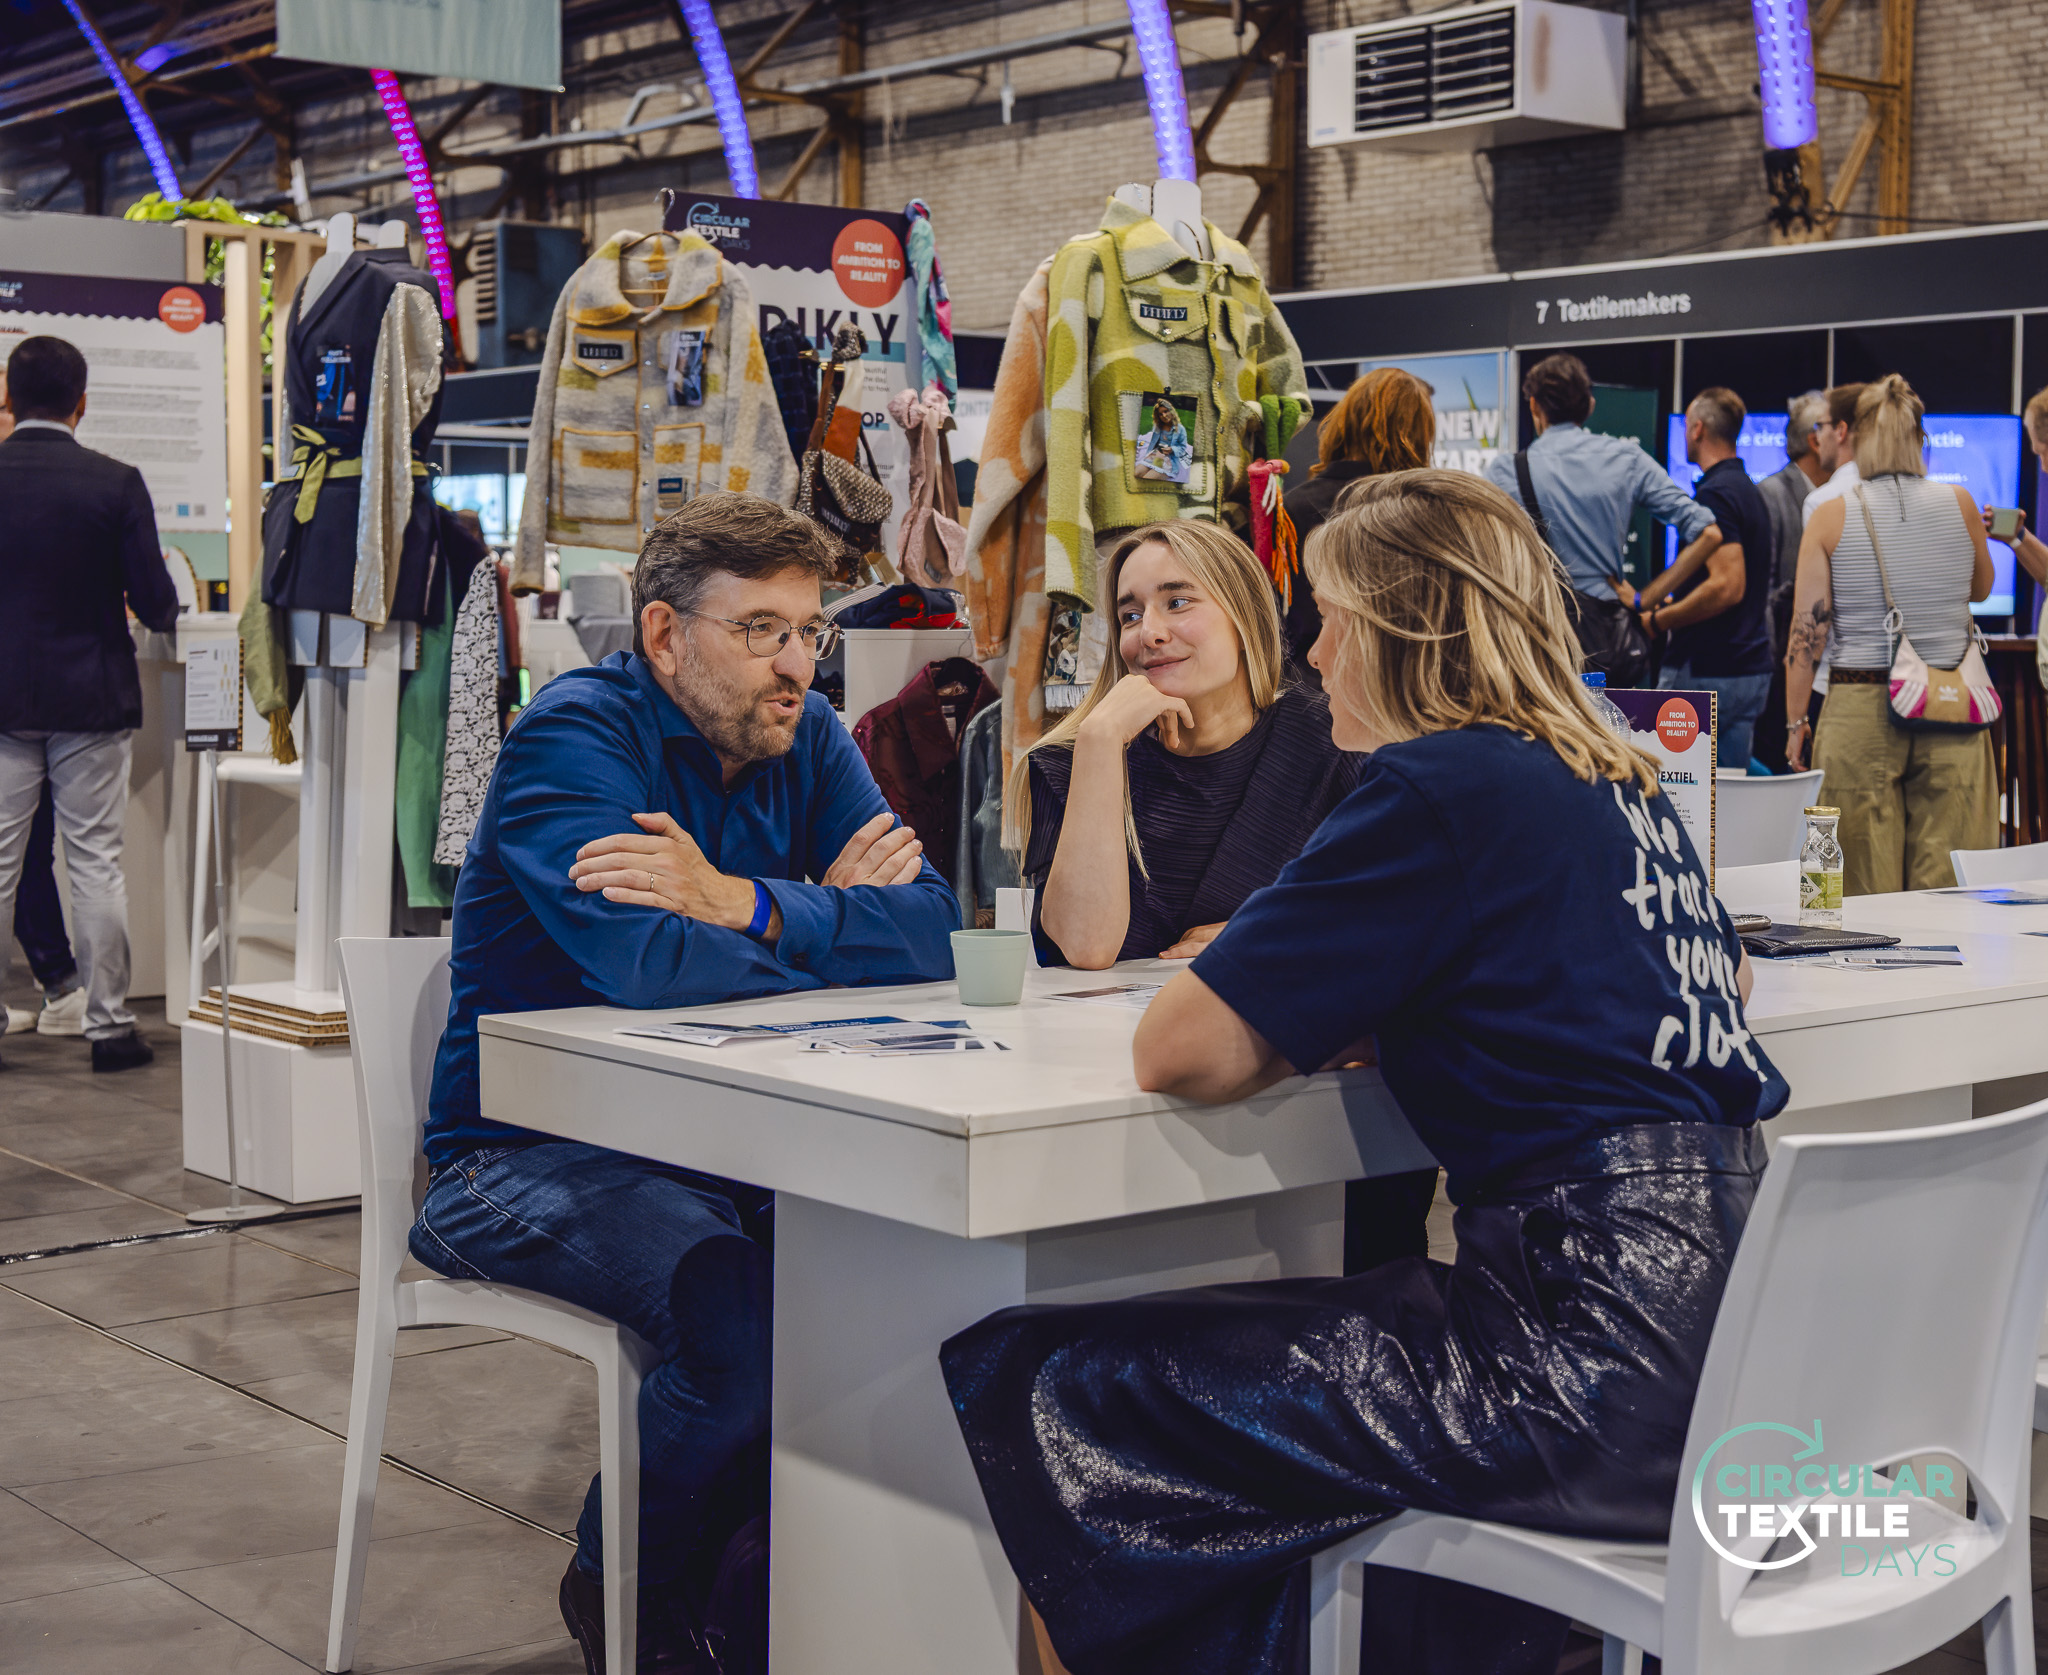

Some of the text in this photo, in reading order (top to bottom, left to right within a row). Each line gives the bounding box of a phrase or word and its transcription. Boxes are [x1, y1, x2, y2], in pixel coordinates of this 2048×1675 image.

[1535, 290, 1692, 325] 7 Textilemakers
[1434, 408, 1499, 441] NEW
[1658, 720, 1687, 728] AMBITION
[1668, 711, 1686, 719] FROM
[1666, 729, 1688, 737] REALITY
[1651, 994, 1768, 1083] clot
